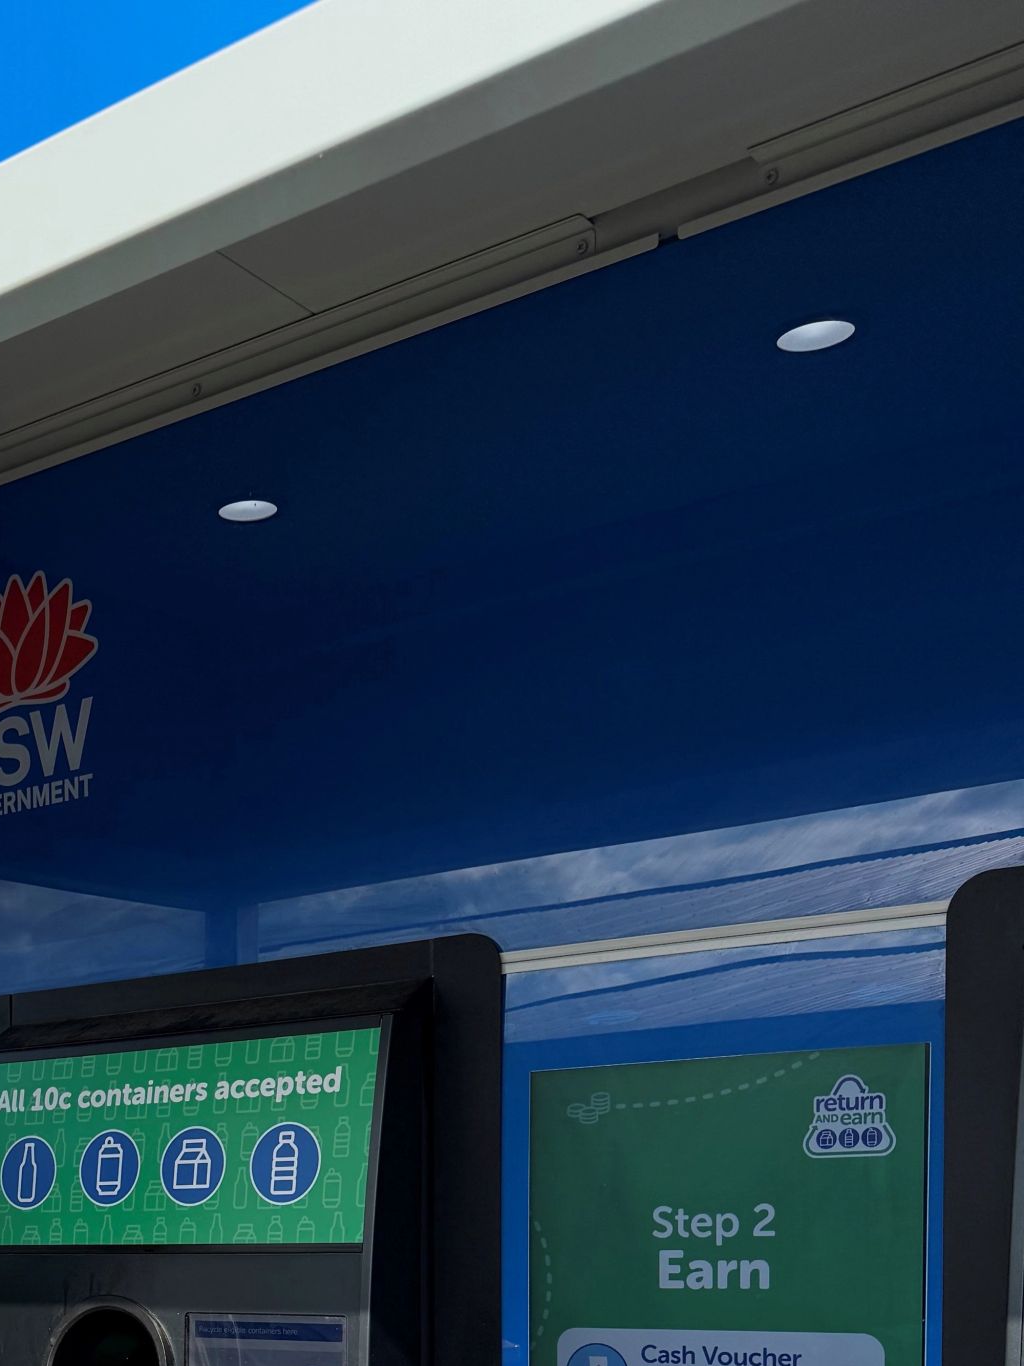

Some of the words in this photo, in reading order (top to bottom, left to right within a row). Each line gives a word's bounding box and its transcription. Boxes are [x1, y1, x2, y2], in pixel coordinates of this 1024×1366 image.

[31, 1087, 72, 1112] 10c
[77, 1079, 208, 1109] containers
[213, 1066, 343, 1102] accepted
[815, 1094, 884, 1113] return
[815, 1114, 839, 1124] AND
[840, 1111, 883, 1126] earn
[651, 1205, 740, 1246] Step
[753, 1203, 776, 1237] 2
[658, 1250, 771, 1290] Earn
[640, 1344, 696, 1365] Cash
